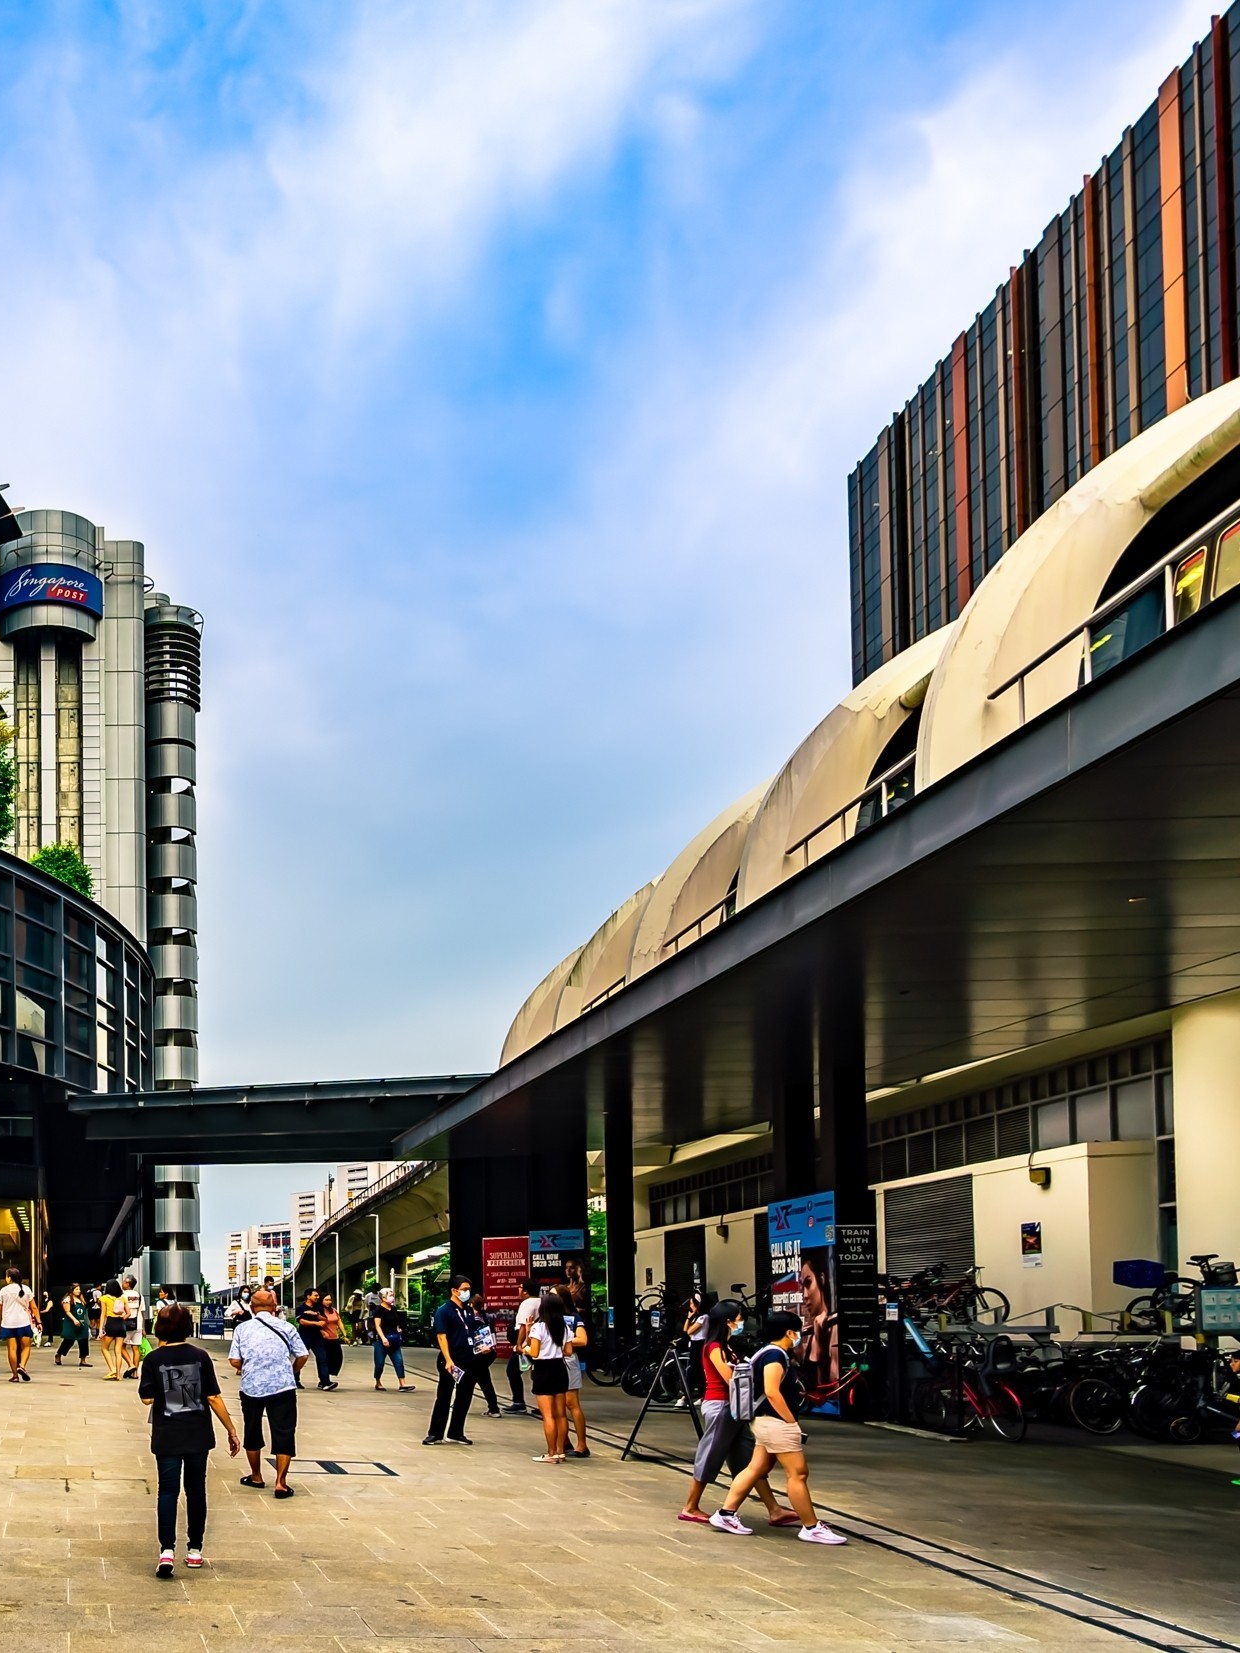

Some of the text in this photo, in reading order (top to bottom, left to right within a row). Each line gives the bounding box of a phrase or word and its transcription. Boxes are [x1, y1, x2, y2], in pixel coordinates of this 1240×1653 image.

[4, 569, 89, 602] Singapore
[56, 588, 85, 601] POST
[770, 1239, 801, 1258] CALL US AT
[532, 1253, 545, 1261] CALL
